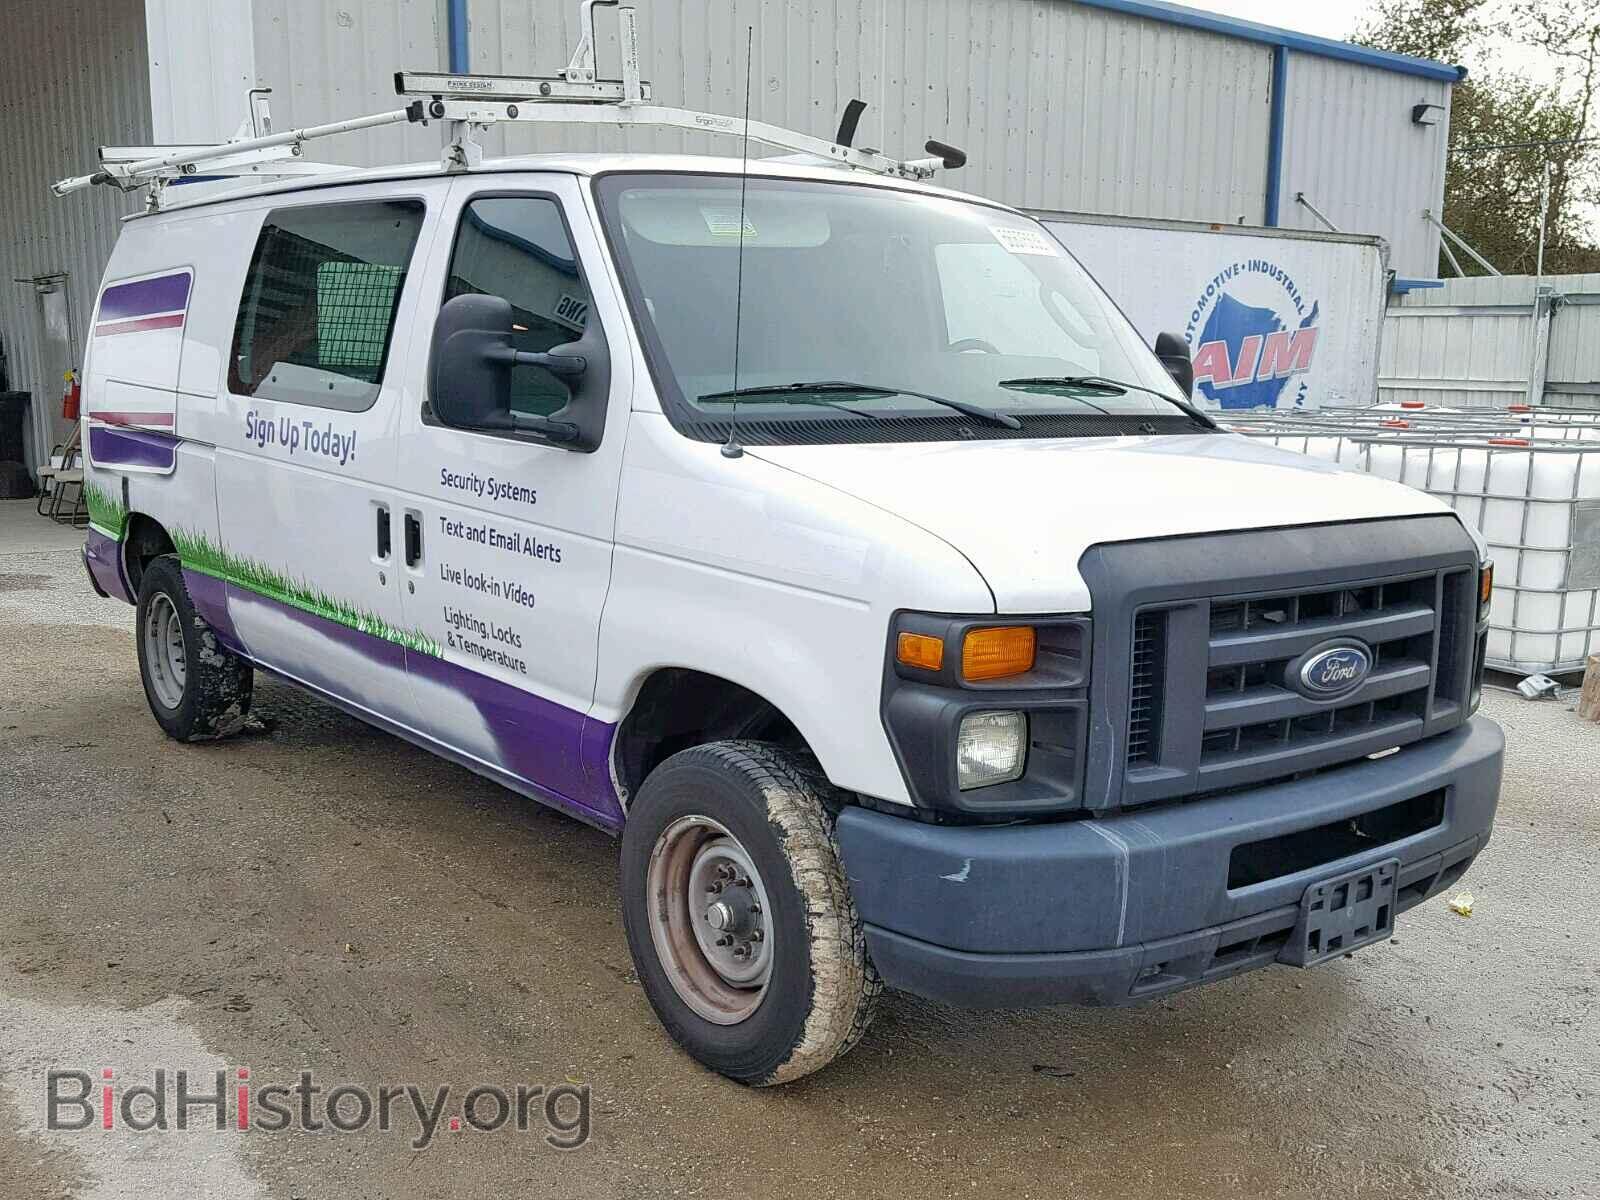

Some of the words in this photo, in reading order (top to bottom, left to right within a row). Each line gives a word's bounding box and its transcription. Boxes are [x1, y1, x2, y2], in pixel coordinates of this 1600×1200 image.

[1185, 263, 1239, 344] UTOMOTIVE
[1248, 259, 1306, 315] INDUSTRIAL
[1191, 327, 1320, 389] AIM
[245, 410, 276, 448] Sign
[280, 416, 300, 455] Up
[302, 421, 357, 466] Today!
[440, 468, 486, 497] Security
[487, 477, 537, 504] Systems
[440, 516, 464, 539] Text
[466, 525, 486, 544] and
[489, 528, 521, 553] Email
[523, 537, 561, 563] Alerts
[440, 563, 462, 585] Live
[463, 568, 501, 597] look-in
[503, 581, 535, 608] Video
[444, 606, 490, 640] Lighting,
[491, 621, 522, 649] Locks
[447, 631, 456, 648] &
[456, 634, 528, 674] Temperature
[1321, 655, 1359, 683] Ford
